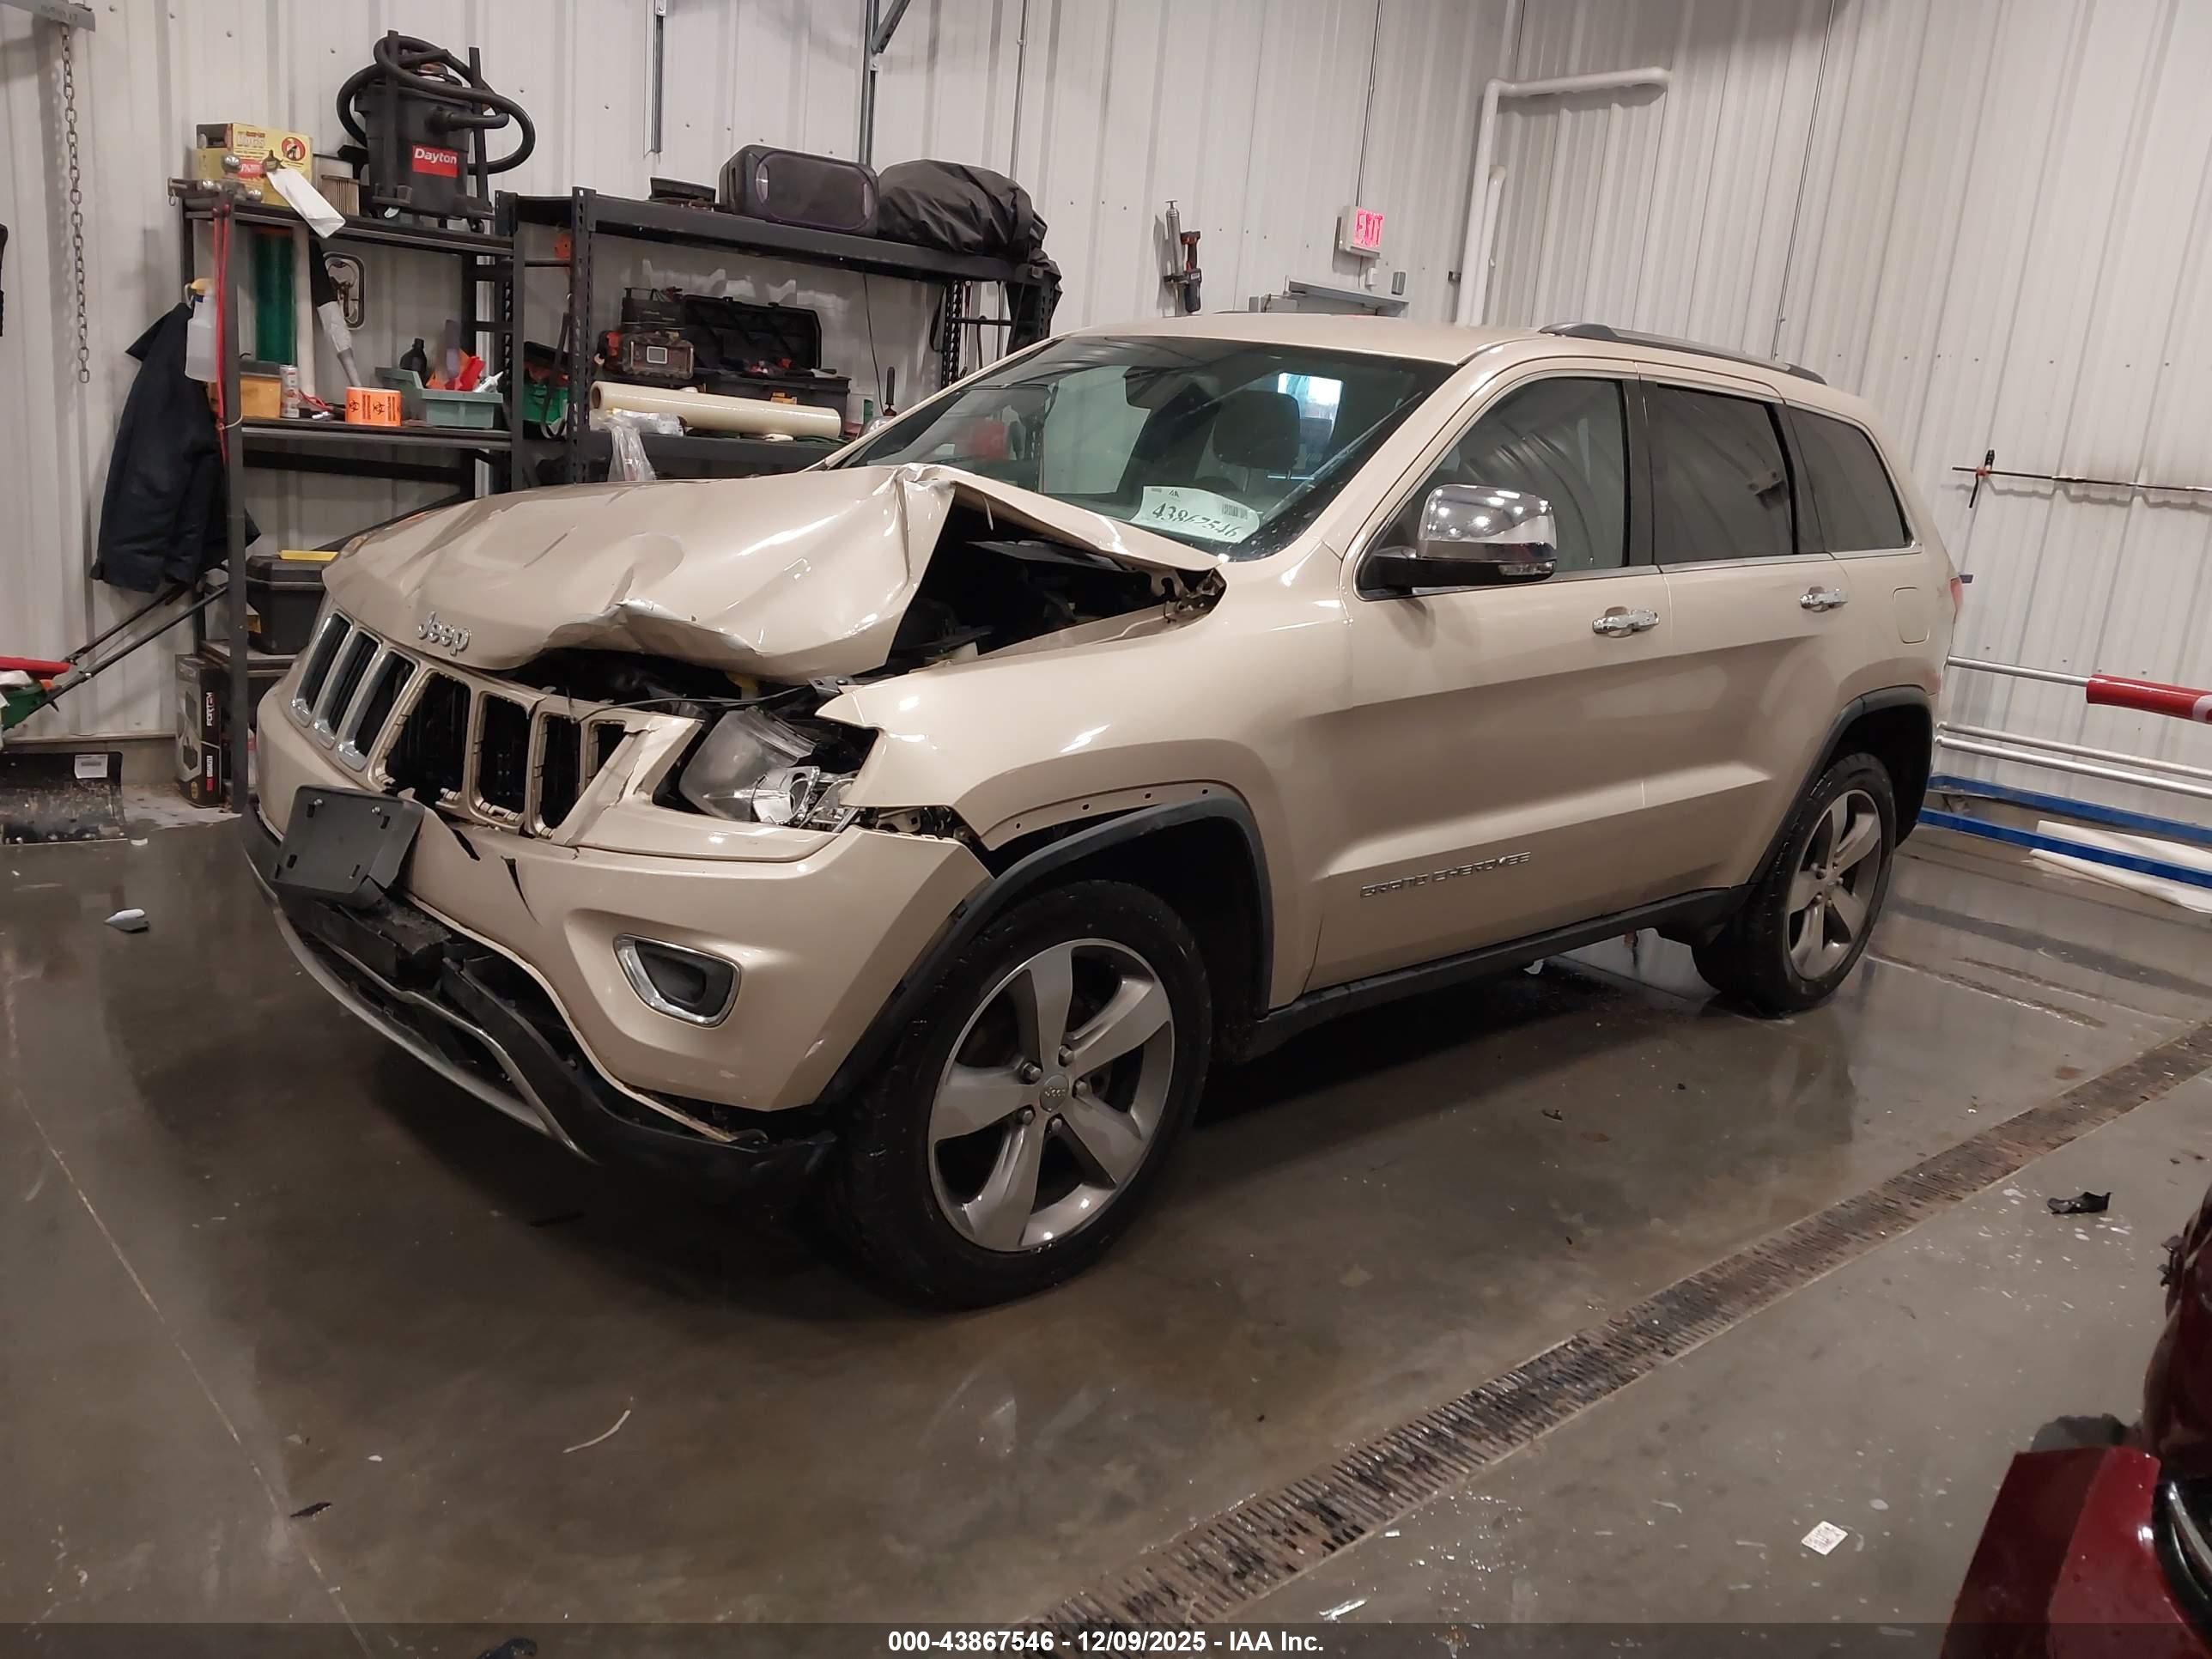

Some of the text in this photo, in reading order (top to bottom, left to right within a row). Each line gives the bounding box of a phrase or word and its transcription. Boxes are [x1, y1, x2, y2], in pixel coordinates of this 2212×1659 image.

[414, 148, 458, 165] Dayton
[1354, 210, 1383, 246] EXIT
[418, 611, 471, 657] Jeep
